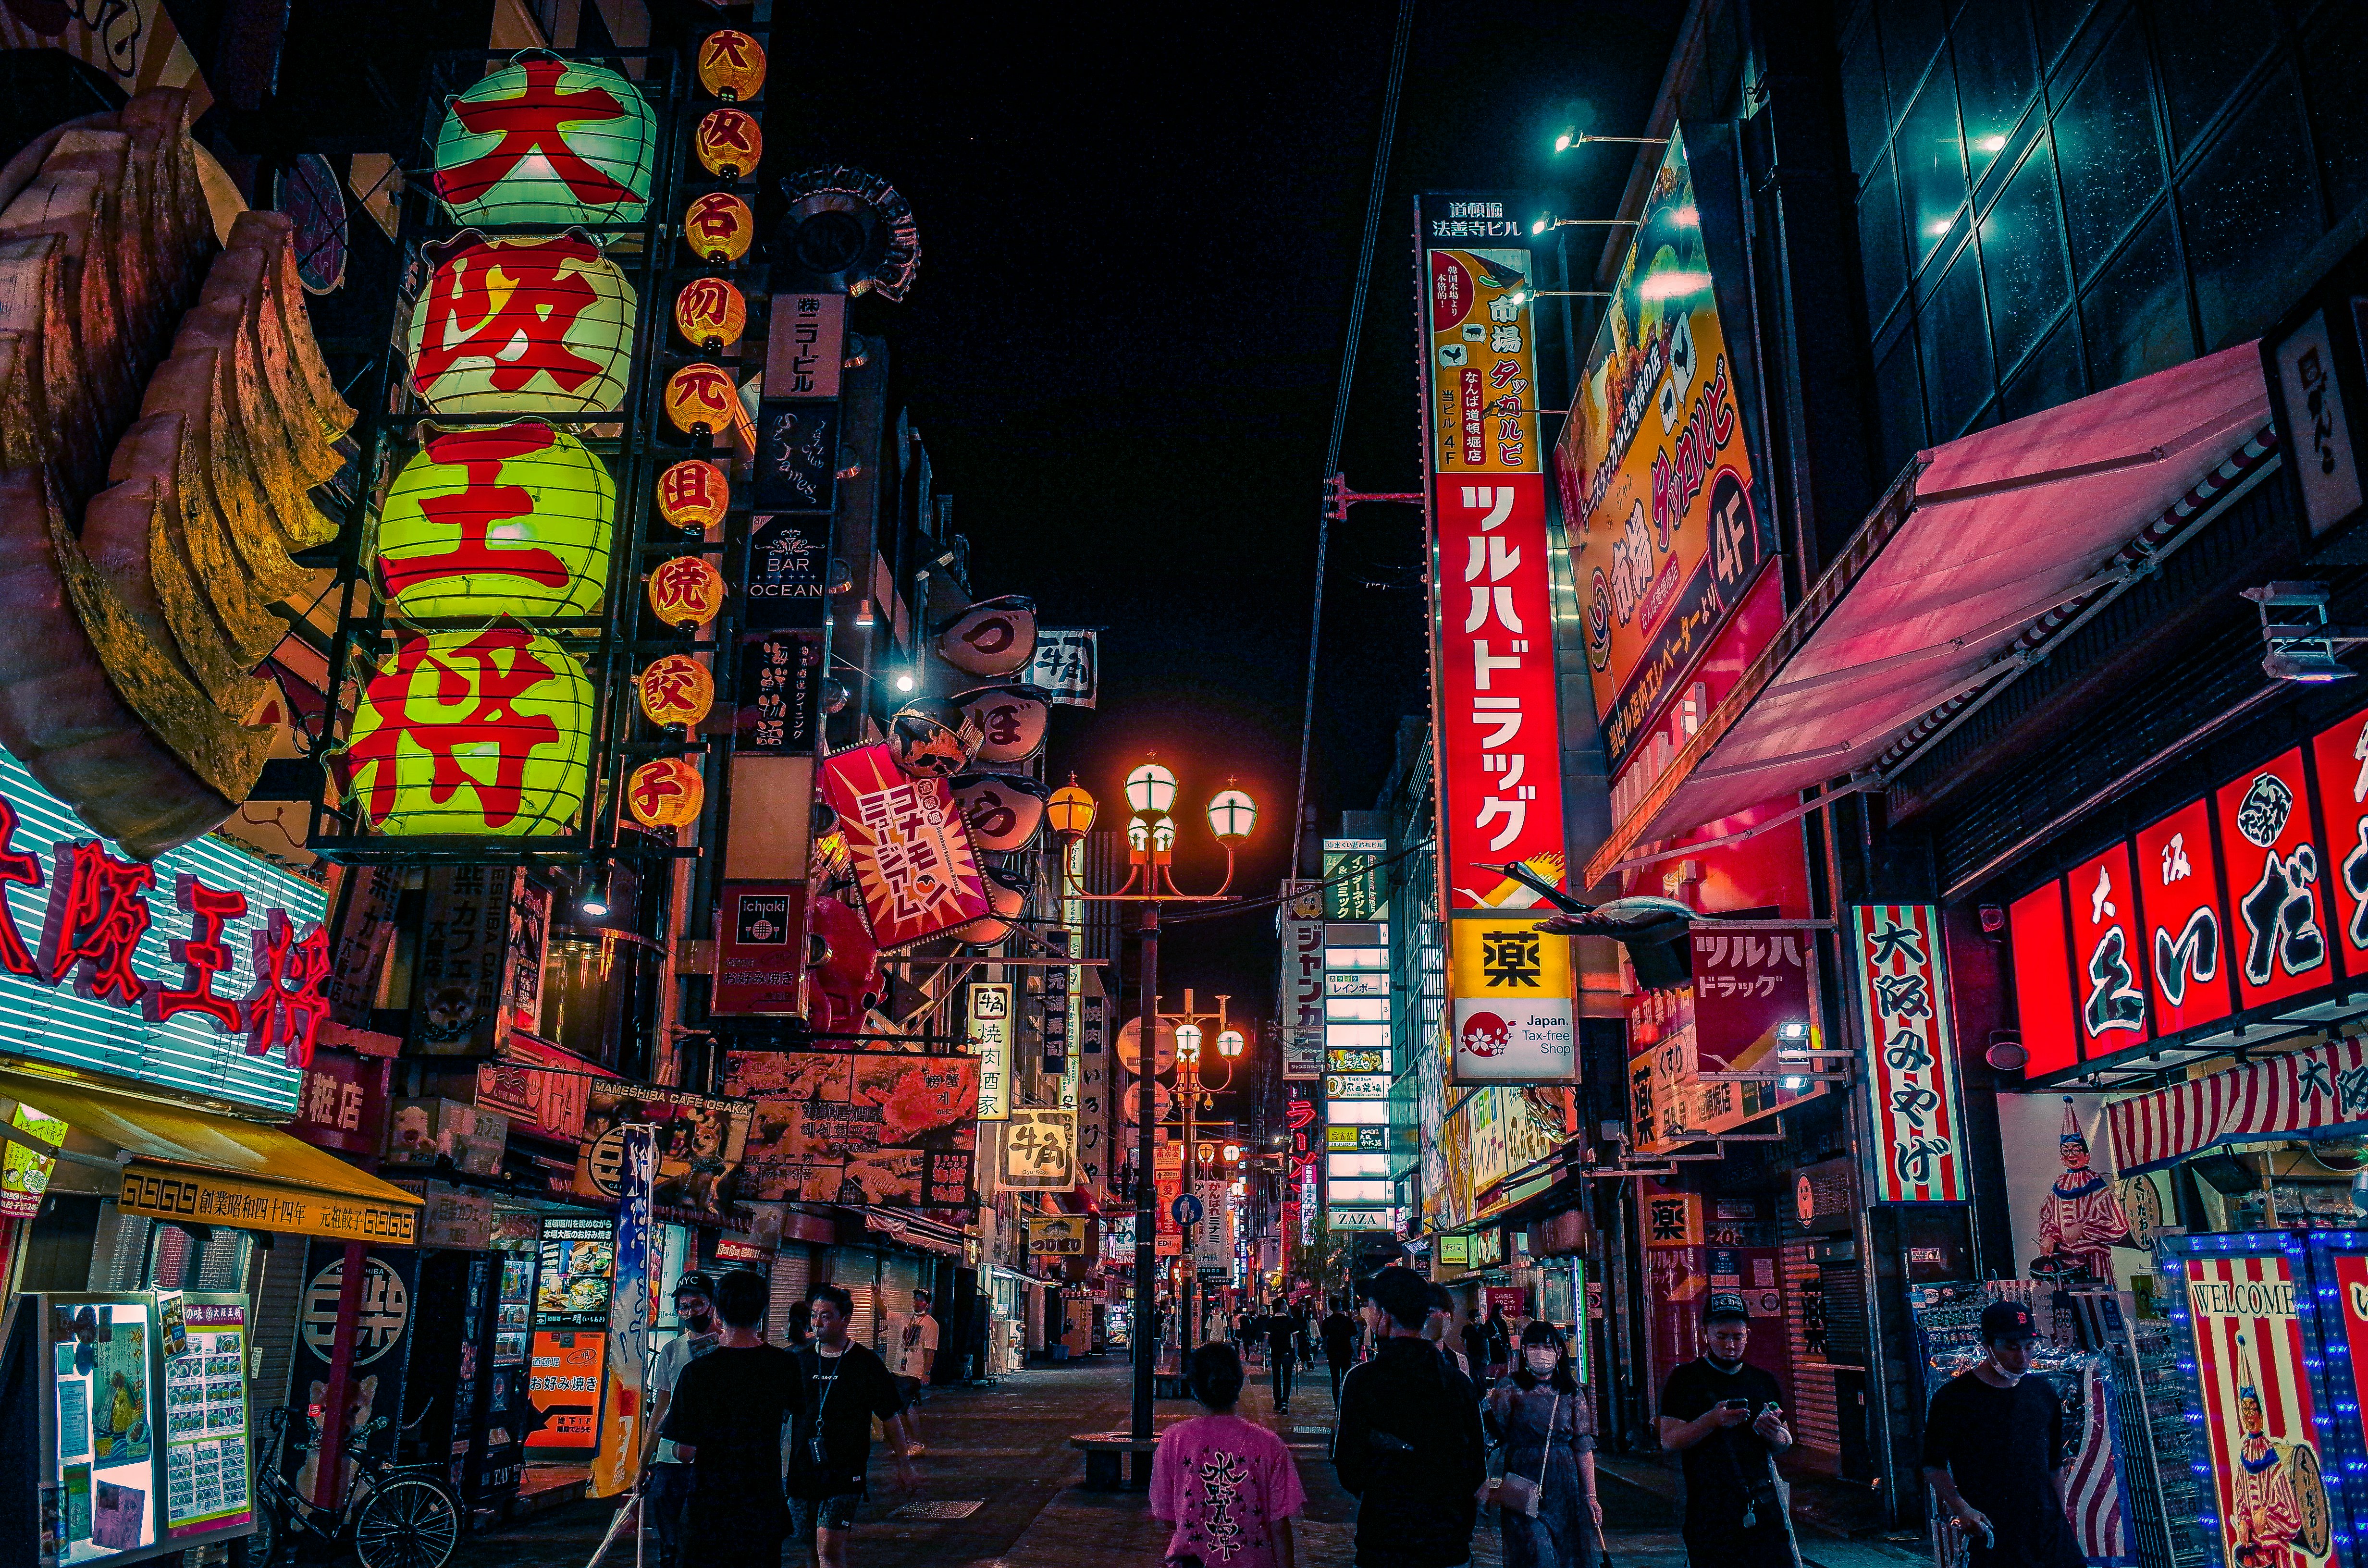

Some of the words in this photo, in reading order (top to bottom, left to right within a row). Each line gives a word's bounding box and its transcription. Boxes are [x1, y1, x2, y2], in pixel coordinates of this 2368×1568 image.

[1450, 203, 1503, 219] 道頓堀
[1432, 220, 1522, 237] 法善寺ビル
[1466, 371, 1482, 463] なんば道頓堀店
[1716, 490, 1746, 584] 4F
[767, 558, 810, 572] BAR
[750, 584, 823, 597] OCEAN
[1460, 485, 1537, 852] ツルハドラッグ
[1382, 931, 1387, 939] 6
[1482, 930, 1542, 987] 薬
[1695, 936, 1802, 968] ツルハ
[1332, 983, 1378, 994] レインボー
[1699, 975, 1783, 997] ドラッグ
[978, 993, 1005, 1013] 牛角
[1527, 1015, 1570, 1028] Japan.
[1522, 1029, 1570, 1041] Tax-free
[1540, 1043, 1571, 1056] Shop
[1869, 921, 1950, 1182] 大阪みやげ
[977, 1024, 1003, 1116] 焼肉酒家
[595, 1082, 666, 1102] MAMESHIBA
[669, 1094, 703, 1108] CAFE
[706, 1100, 750, 1115] OSAKA
[1009, 1126, 1065, 1170] 牛角
[199, 1188, 307, 1226] 創業昭和四十四年
[319, 1205, 363, 1231] 元祖餃子
[544, 1219, 612, 1229] 道頓堀川を眺めながら
[1338, 1214, 1377, 1225] ZAZA
[1652, 1199, 1685, 1240] 薬
[543, 1230, 612, 1239] 本場大阪のお好み焼き
[336, 1267, 384, 1275] MHIBA
[2195, 1284, 2295, 1315] WELCOME
[531, 1357, 560, 1368] 道頓堀
[529, 1376, 597, 1392] お好み焼き
